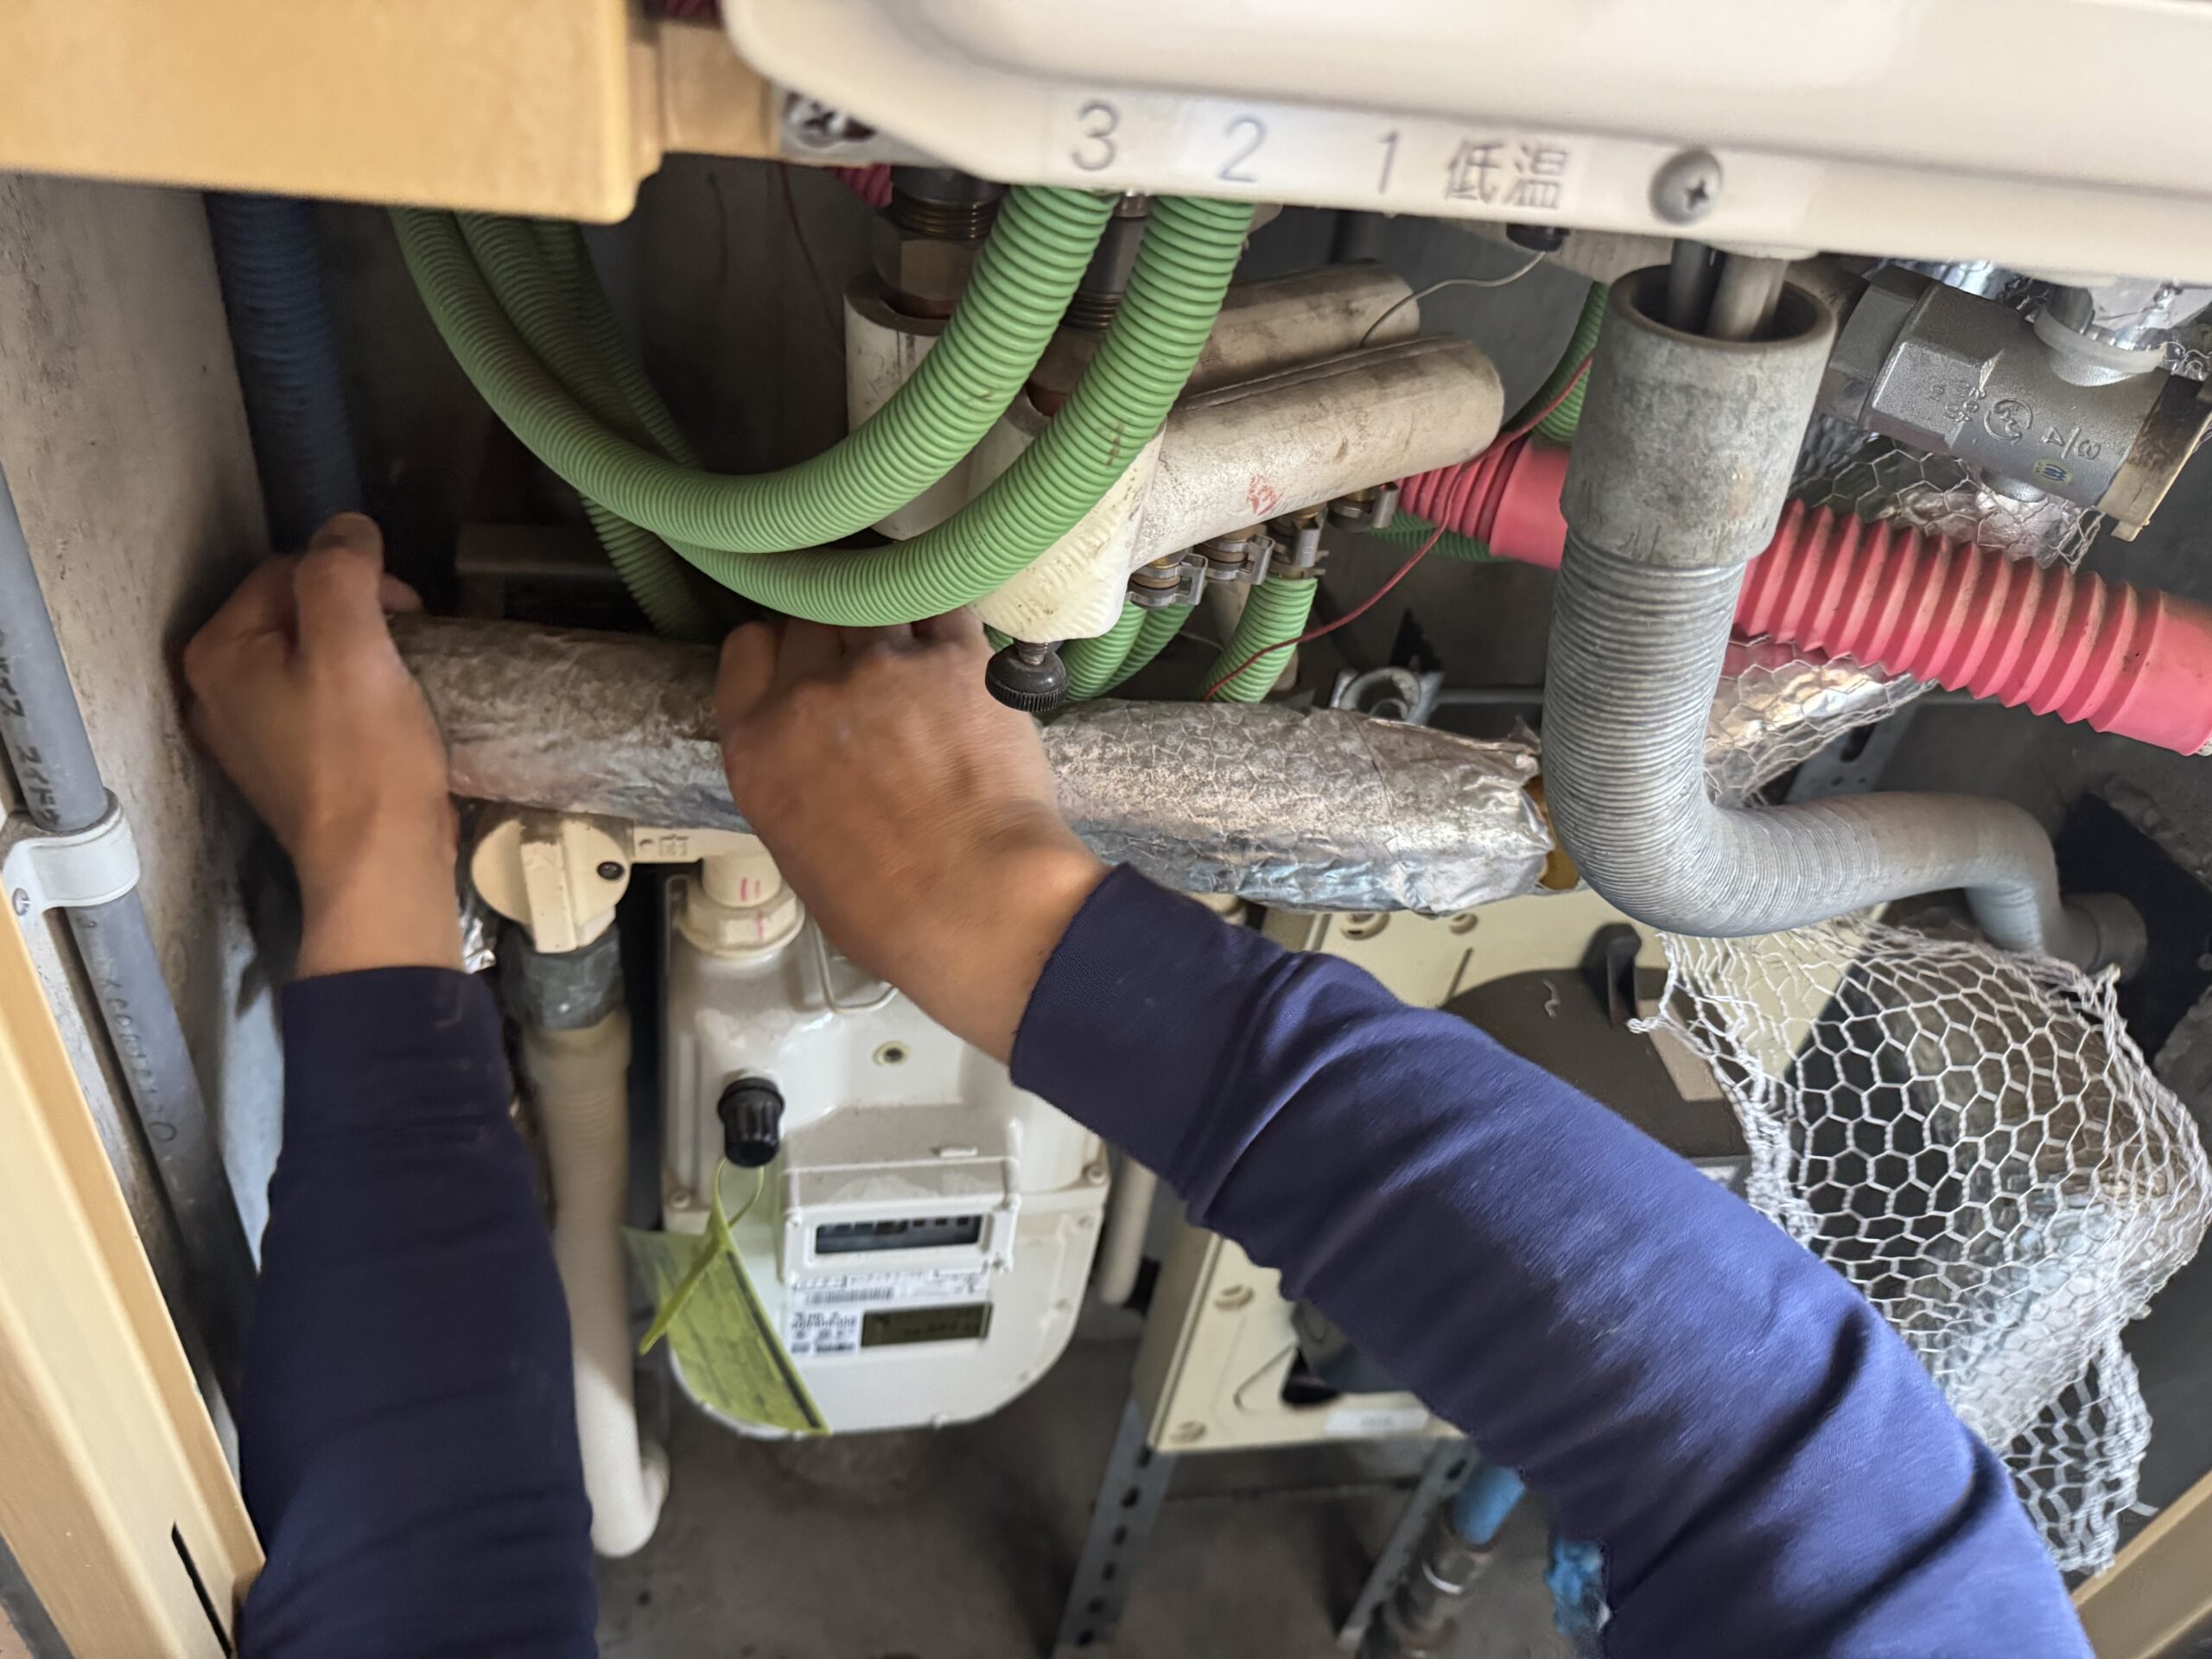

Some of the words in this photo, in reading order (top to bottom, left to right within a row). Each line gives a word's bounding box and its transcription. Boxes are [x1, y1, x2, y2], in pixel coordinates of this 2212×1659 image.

[1071, 99, 1119, 172] 3
[1217, 114, 1268, 184] 2
[1377, 129, 1400, 195] 1
[1444, 138, 1568, 210] 低温
